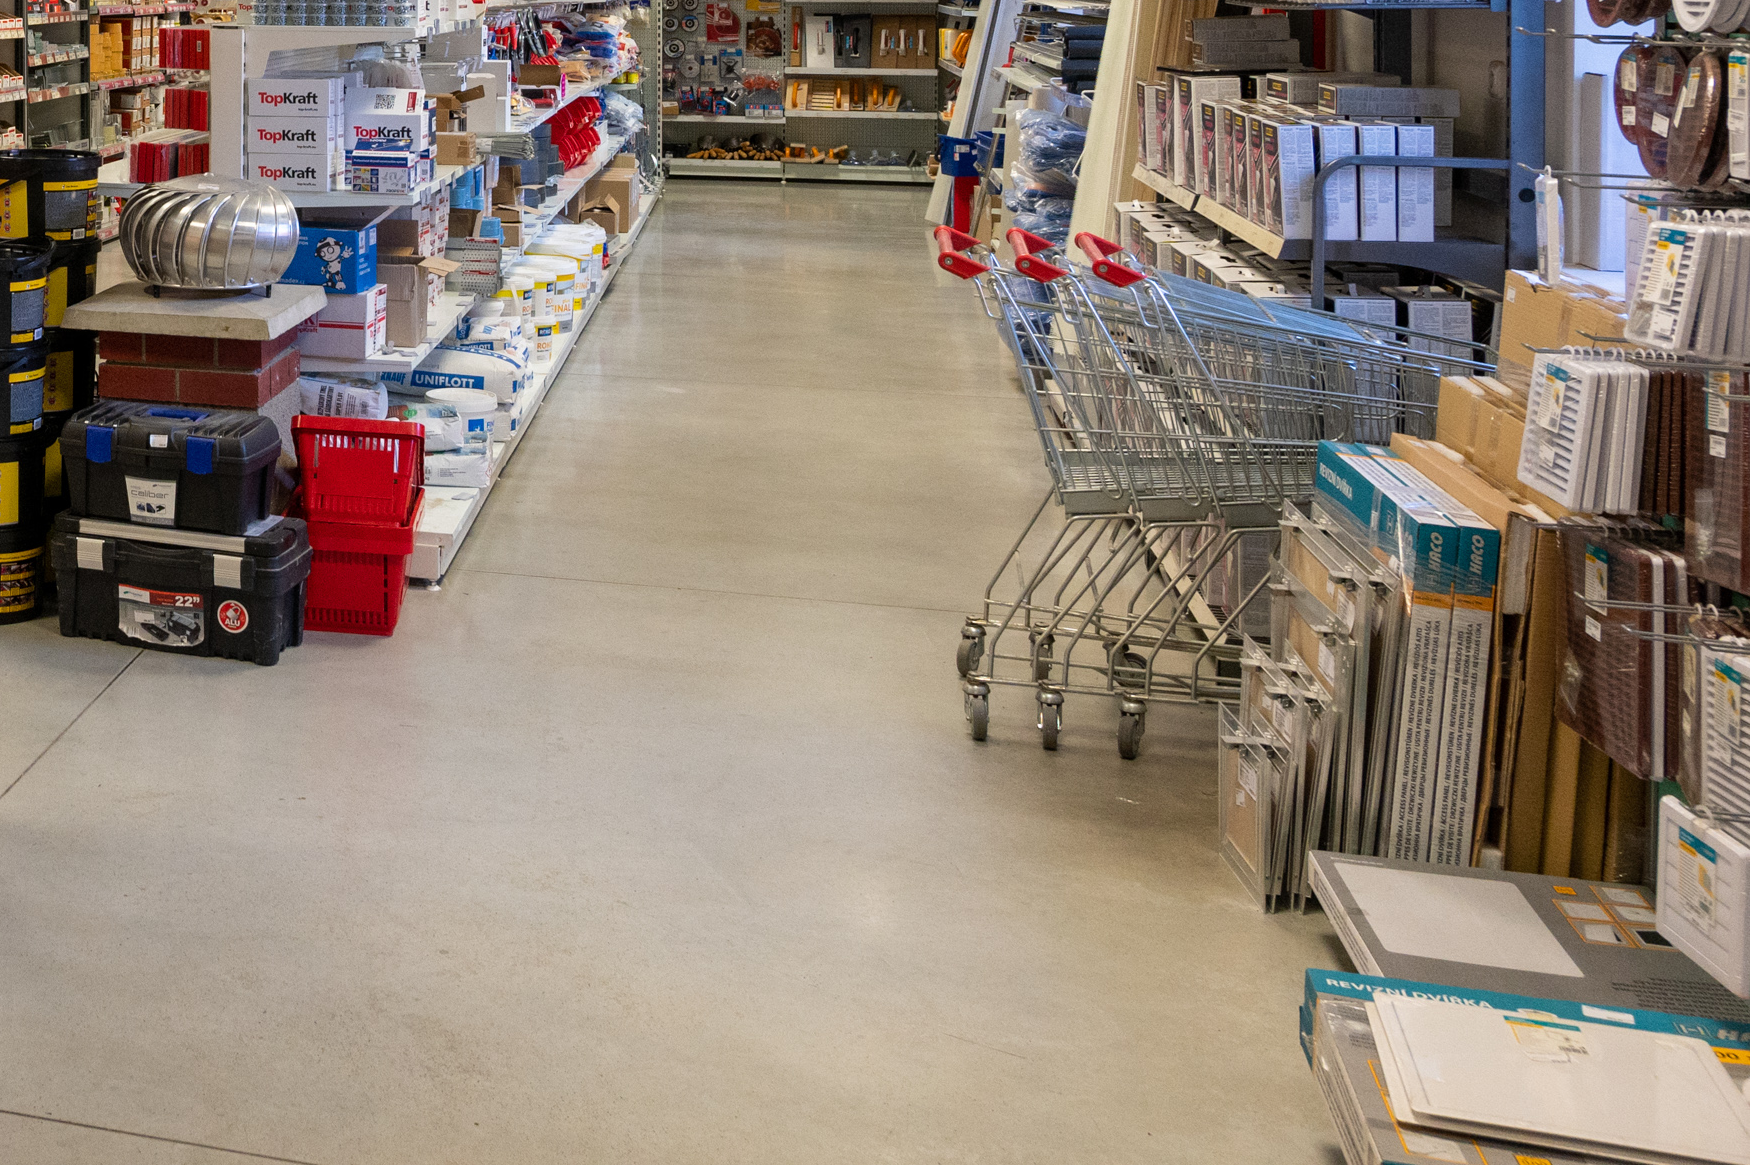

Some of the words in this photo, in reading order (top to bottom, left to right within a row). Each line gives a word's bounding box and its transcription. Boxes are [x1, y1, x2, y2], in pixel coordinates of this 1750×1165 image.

[258, 92, 319, 107] TopKraft
[257, 129, 317, 144] TopKraft
[353, 125, 412, 140] TopKraft
[257, 166, 317, 181] TopKraft
[415, 375, 475, 389] UNIFLOTT
[130, 489, 169, 500] caliber
[1428, 531, 1444, 572] HACO
[1469, 534, 1486, 575] HACO
[224, 617, 241, 627] ALU
[1403, 728, 1412, 776] REVISIONSTÜREN
[1408, 700, 1416, 723] REVÍZNE
[1450, 788, 1458, 819] DRZWICZKI
[1462, 655, 1470, 685] REVIZIONA
[1444, 732, 1454, 781] REVISIONSTÜREN
[1415, 803, 1423, 832] ВРАТИЧКА
[1421, 729, 1430, 772] РЕВИЗИОННЫЕ
[1408, 784, 1416, 815] DRZWICZKI
